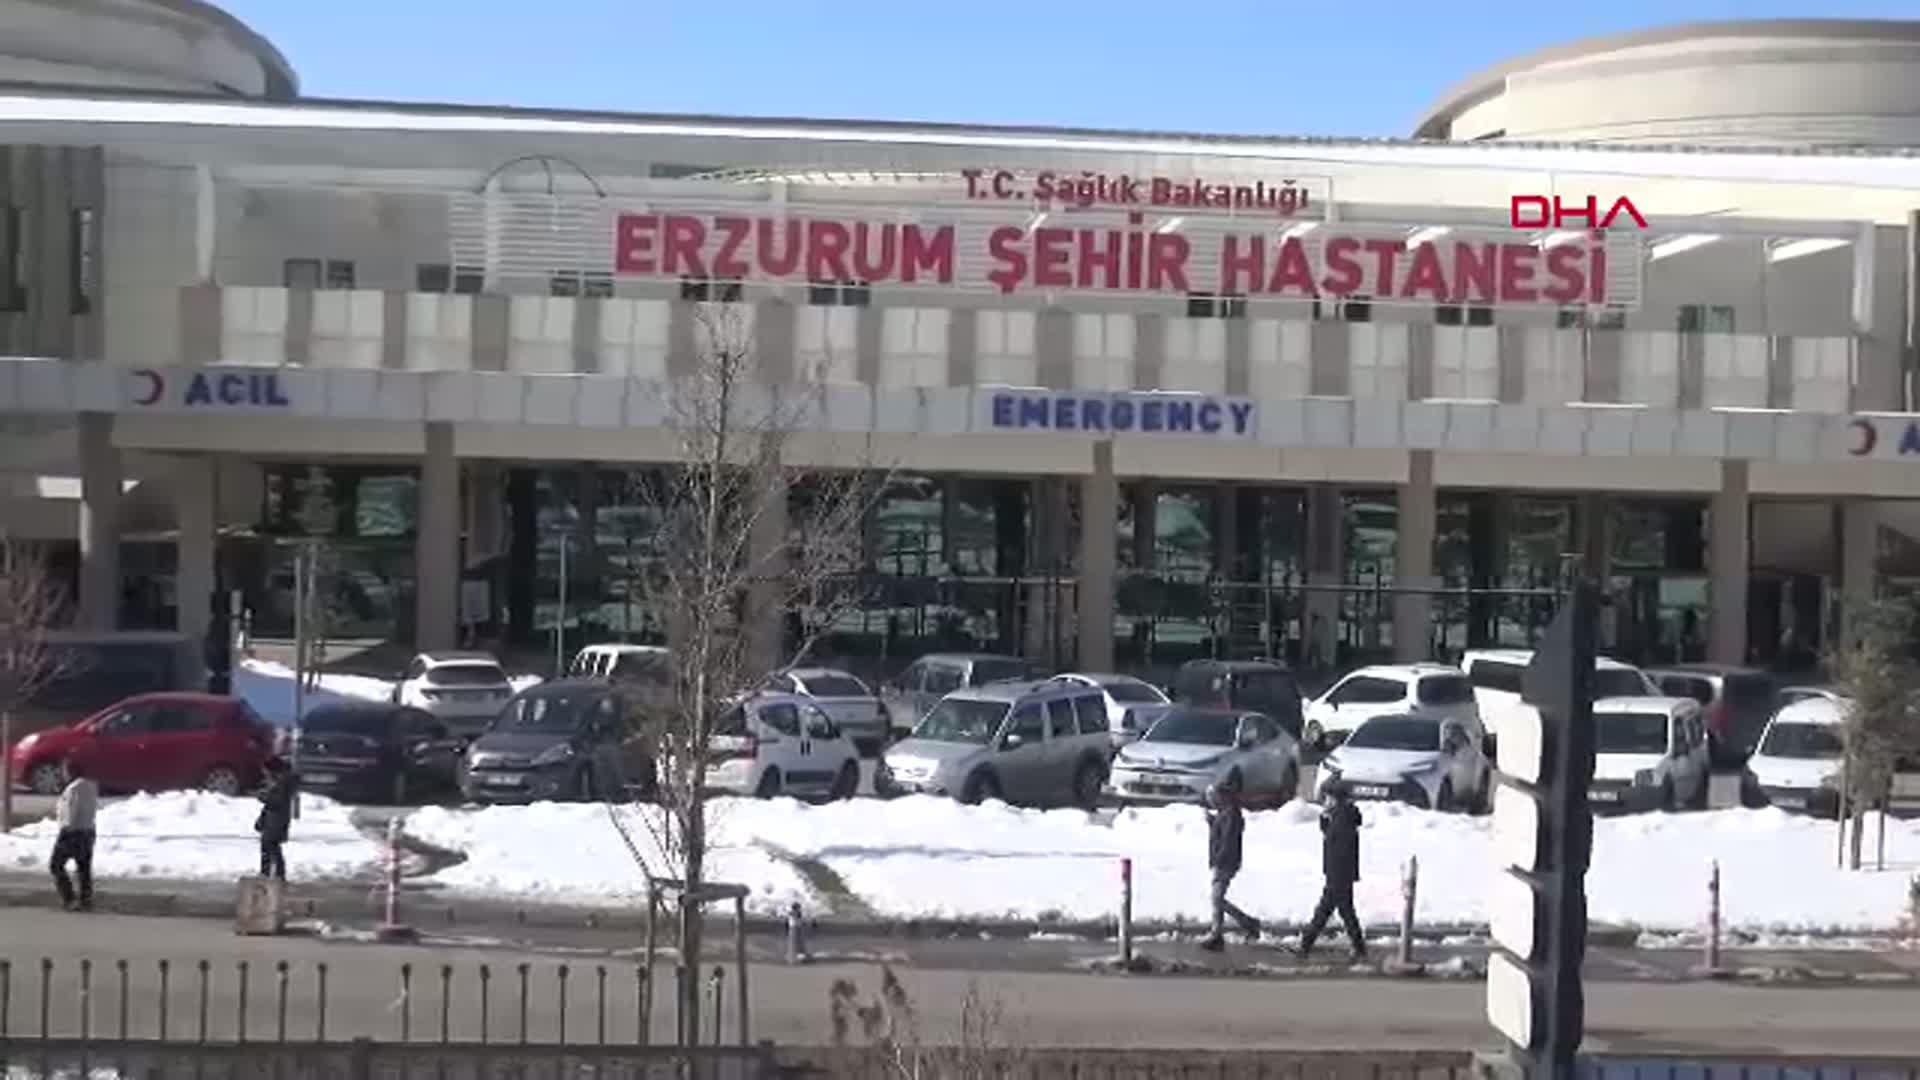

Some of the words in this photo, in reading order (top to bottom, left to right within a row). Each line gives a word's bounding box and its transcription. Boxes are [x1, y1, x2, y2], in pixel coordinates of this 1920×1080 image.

[1033, 170, 1139, 207] Sağlık
[1152, 177, 1311, 215] Bakanlığı
[615, 212, 955, 284] ERZURUM
[988, 211, 1190, 294] ŞEHİR
[1221, 229, 1607, 304] HASTANESİ
[992, 393, 1253, 435] EMERGENCY
